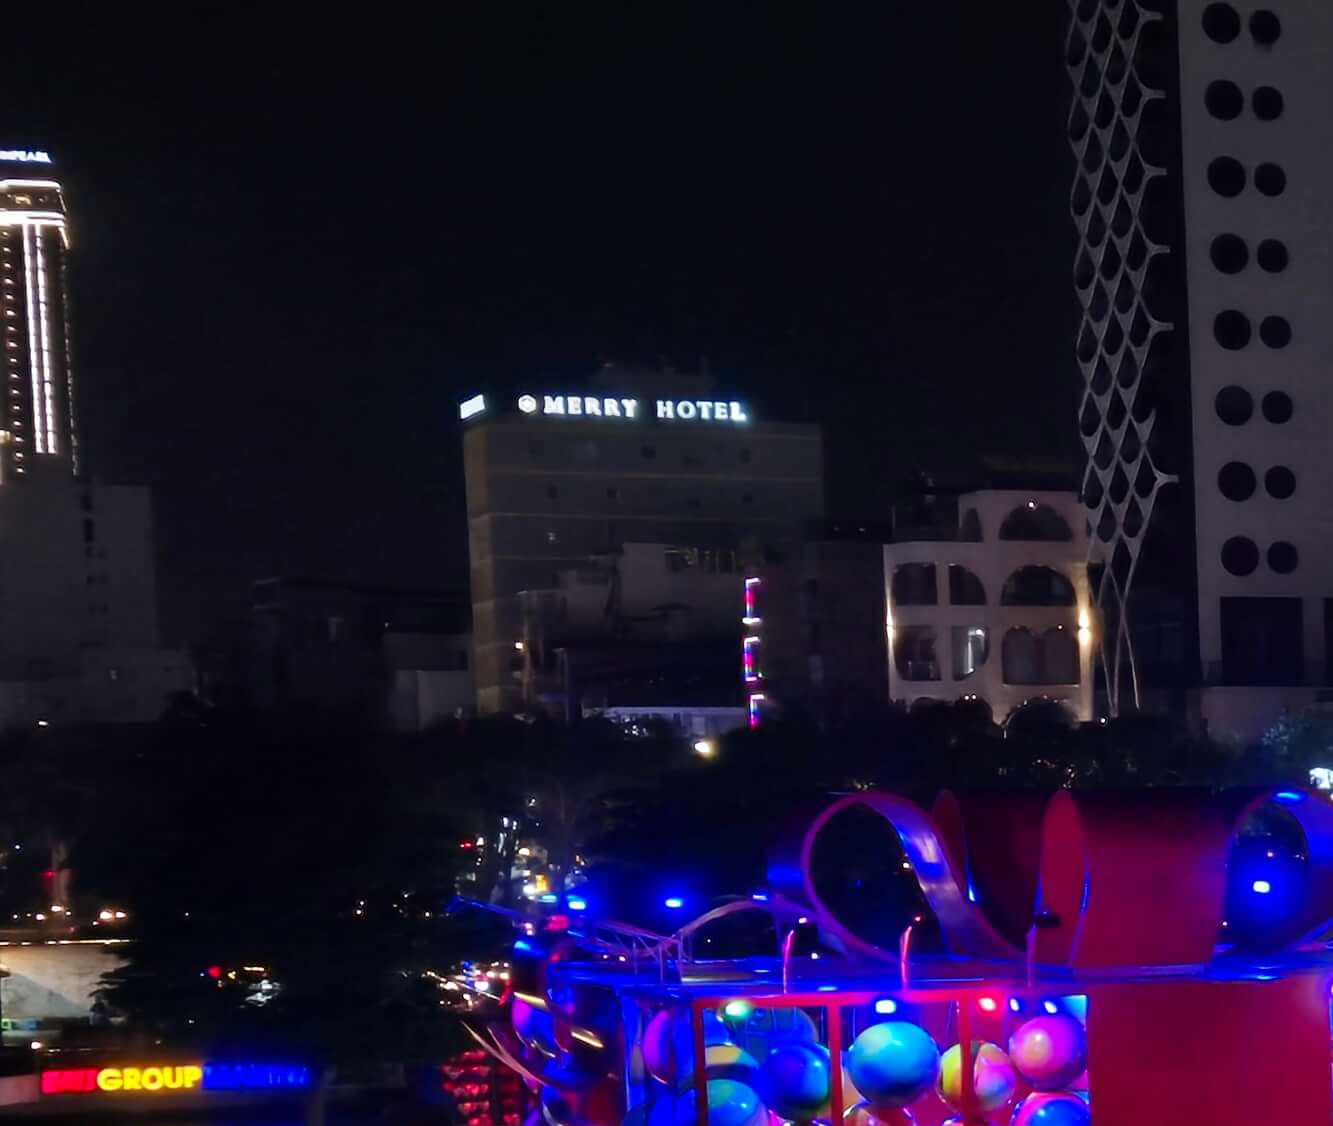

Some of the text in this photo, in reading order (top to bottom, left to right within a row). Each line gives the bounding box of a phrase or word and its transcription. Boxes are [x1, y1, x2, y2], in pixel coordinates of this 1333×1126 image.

[543, 395, 748, 422] MERRY HOTEL
[97, 1065, 203, 1091] GROUP
